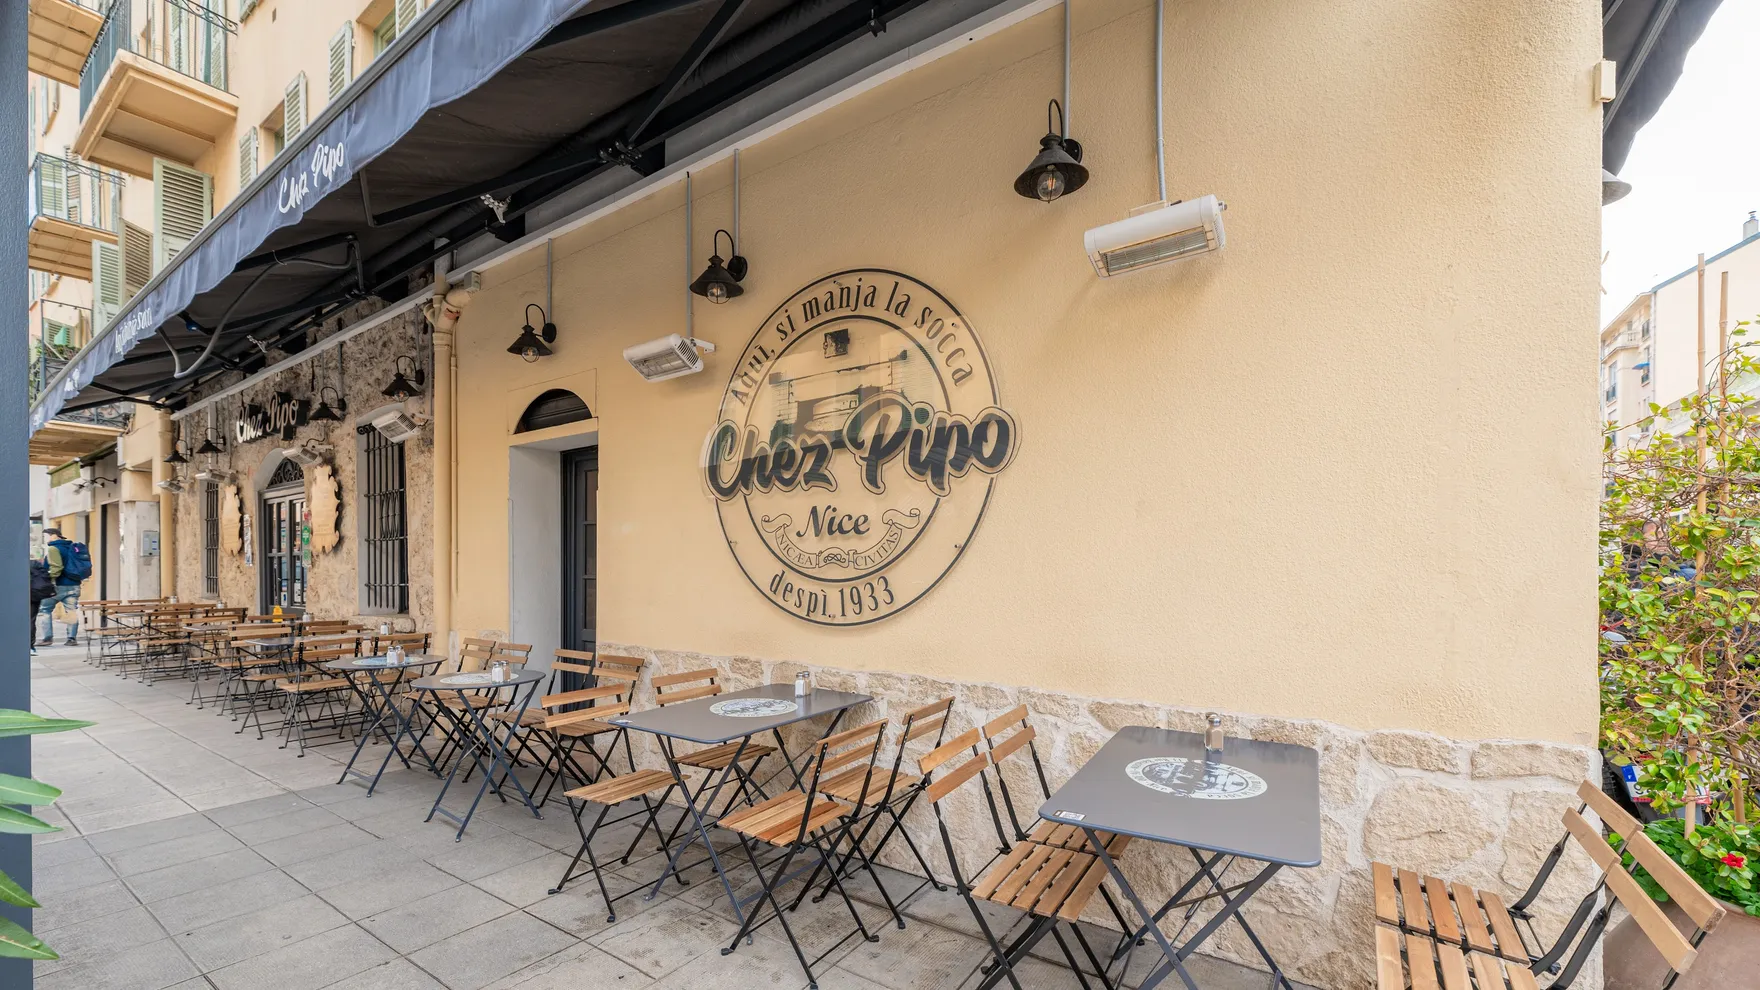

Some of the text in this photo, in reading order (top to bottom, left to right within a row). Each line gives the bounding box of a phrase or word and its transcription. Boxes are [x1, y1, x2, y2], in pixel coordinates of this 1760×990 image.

[311, 142, 344, 187] Pipo
[776, 309, 797, 342] si
[801, 277, 877, 323] manja
[884, 281, 911, 318] la
[913, 306, 973, 387] socca
[236, 392, 299, 444] Chez Pipo
[706, 394, 1013, 500] Chez Pipo
[796, 504, 870, 538] Nice
[855, 529, 900, 568] CIVITAS
[836, 575, 895, 617] 1933
